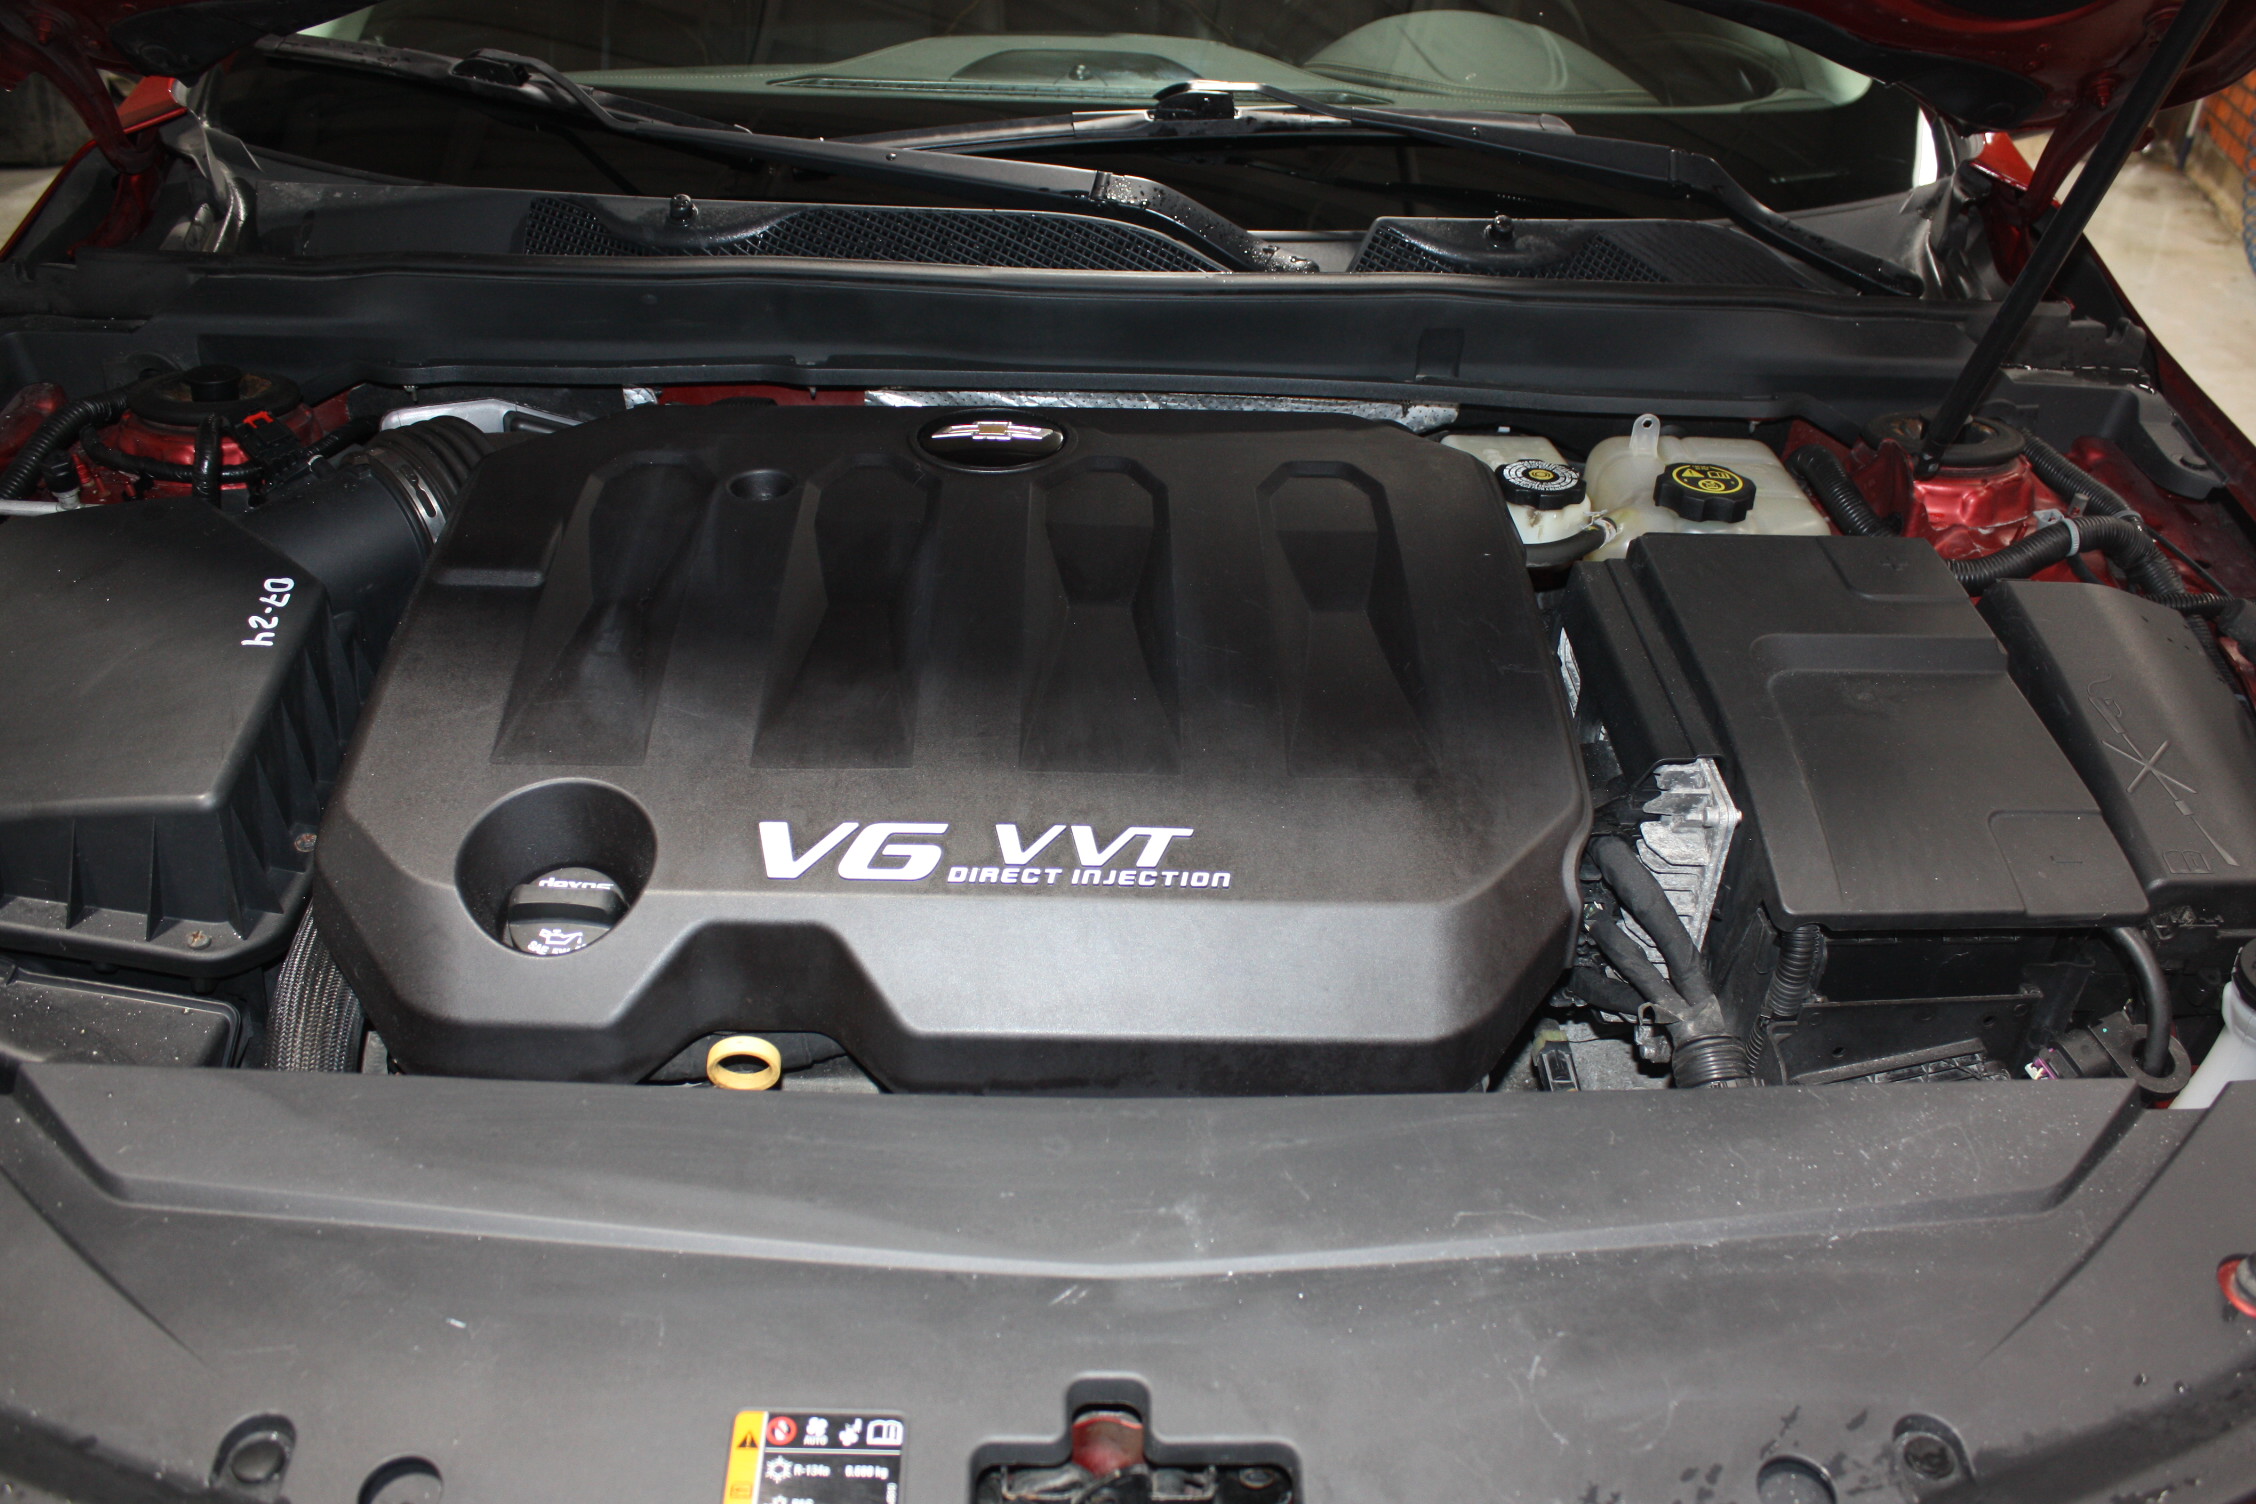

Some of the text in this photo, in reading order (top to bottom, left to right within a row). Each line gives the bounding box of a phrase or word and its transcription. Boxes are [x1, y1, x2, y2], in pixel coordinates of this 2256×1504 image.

[759, 821, 1194, 880] V6 VVT
[947, 866, 1232, 888] DIRECT INJECTION
[527, 940, 550, 955] SAE
[803, 1434, 828, 1446] AUTO
[793, 1463, 831, 1477] R-134a
